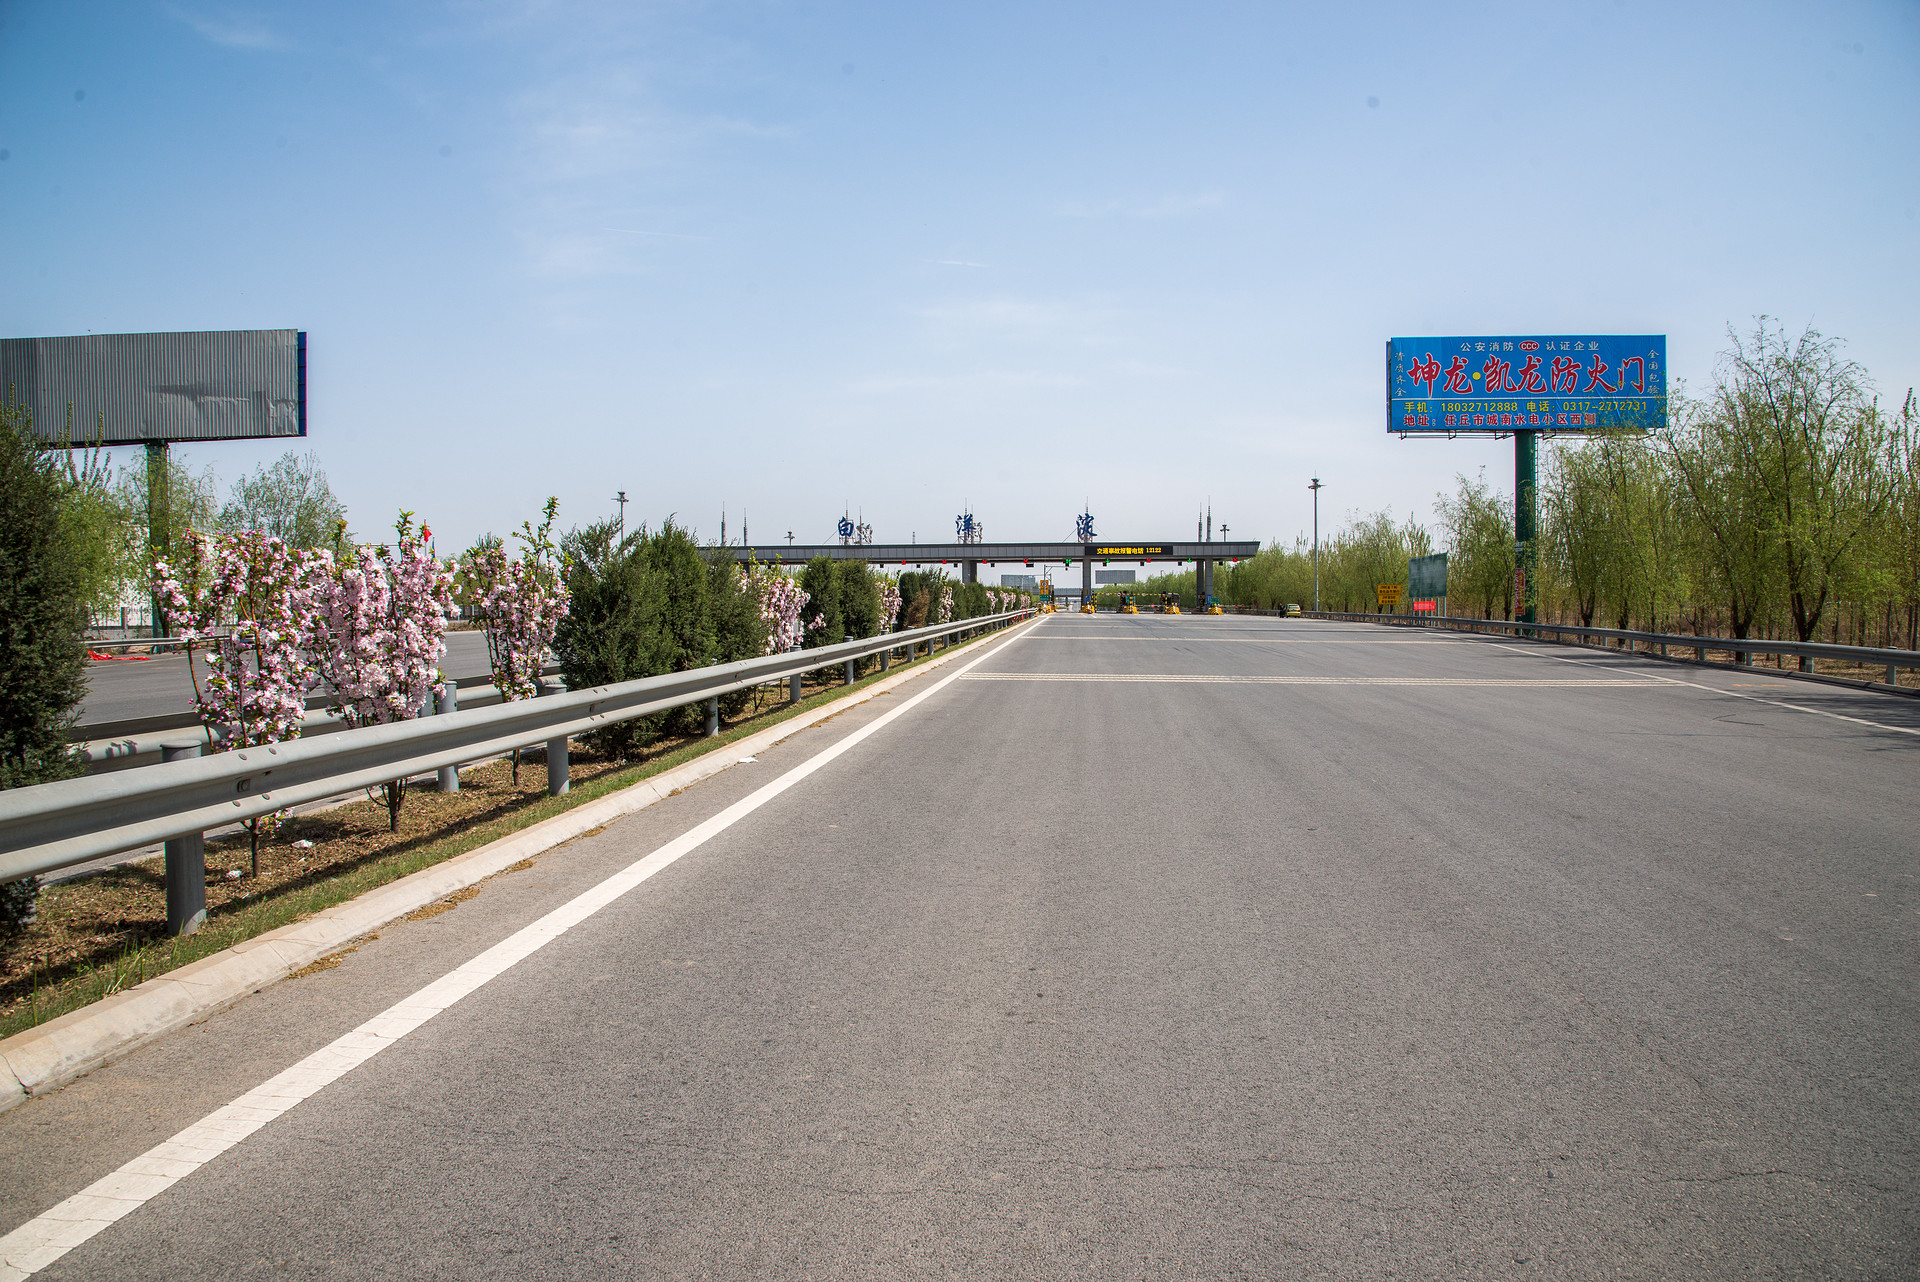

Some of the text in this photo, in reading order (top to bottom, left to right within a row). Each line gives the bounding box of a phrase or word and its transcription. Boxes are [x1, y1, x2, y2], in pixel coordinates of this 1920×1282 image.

[1460, 340, 1600, 352] 公安消防 CCC 认证企业
[1394, 351, 1407, 397] 资质齐全
